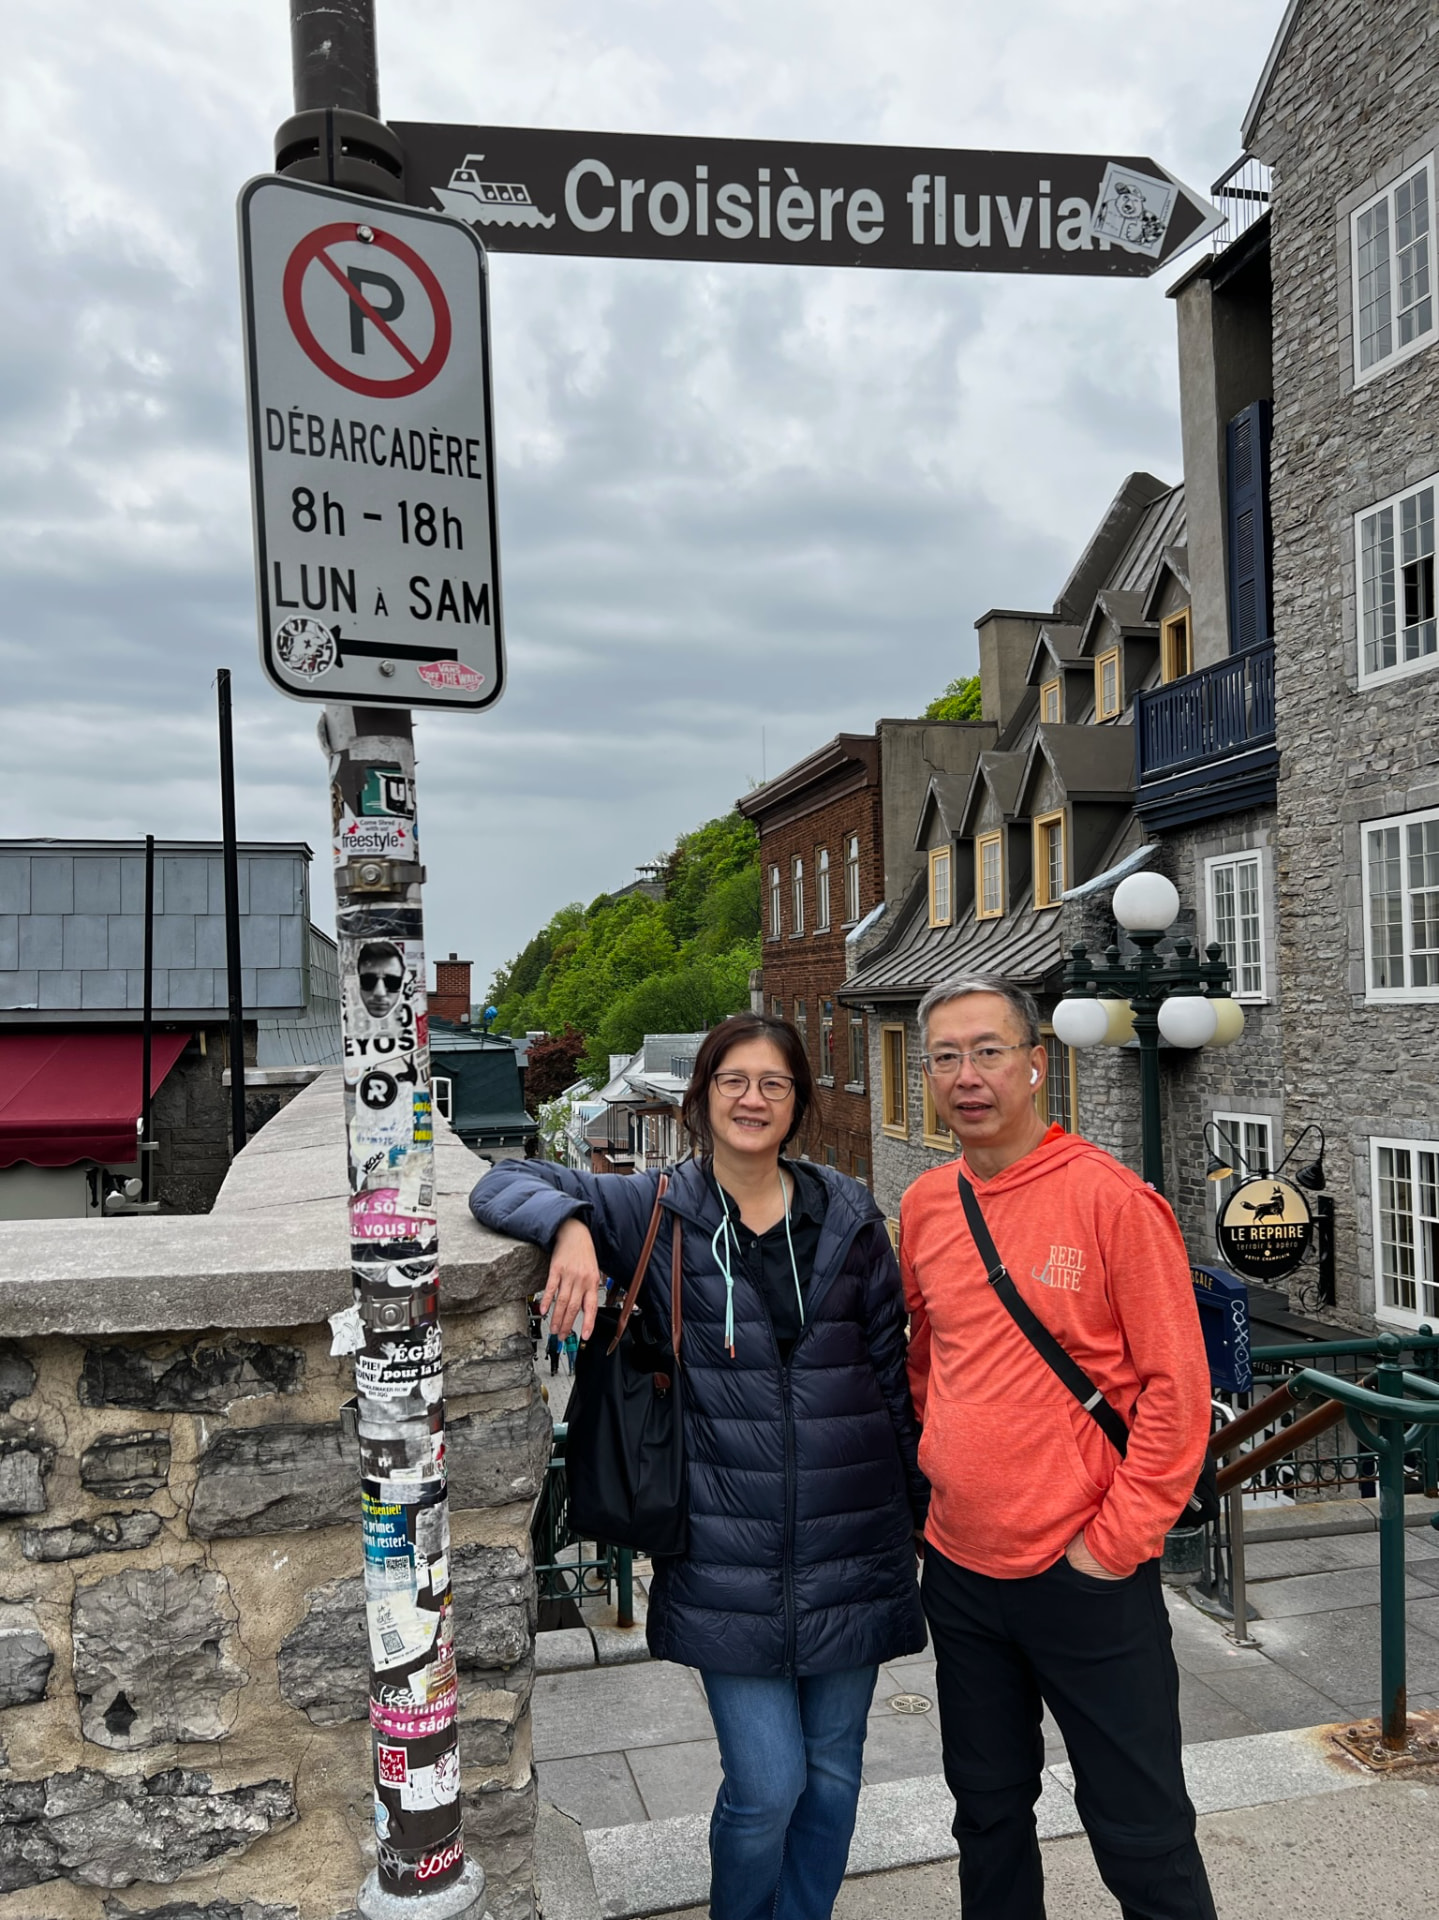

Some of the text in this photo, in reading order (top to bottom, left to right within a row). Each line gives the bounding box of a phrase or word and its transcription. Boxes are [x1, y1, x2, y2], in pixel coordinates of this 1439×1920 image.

[565, 158, 1142, 254] Croisière fluvia
[266, 405, 482, 480] DÉBARCADÈRE
[292, 486, 345, 536] 8h
[398, 500, 463, 550] 18h
[273, 561, 491, 626] LUN À SAM
[437, 663, 461, 674] VANS
[364, 1222, 407, 1236] vous
[1231, 1225, 1304, 1241] LE REPAIRE
[1236, 1241, 1264, 1250] terroir
[1276, 1241, 1298, 1251] apéro
[1049, 1245, 1086, 1271] REEL
[1049, 1266, 1081, 1292] LIFE
[383, 1367, 419, 1381] pour
[368, 1520, 395, 1534] primes
[377, 1533, 407, 1549] rester!
